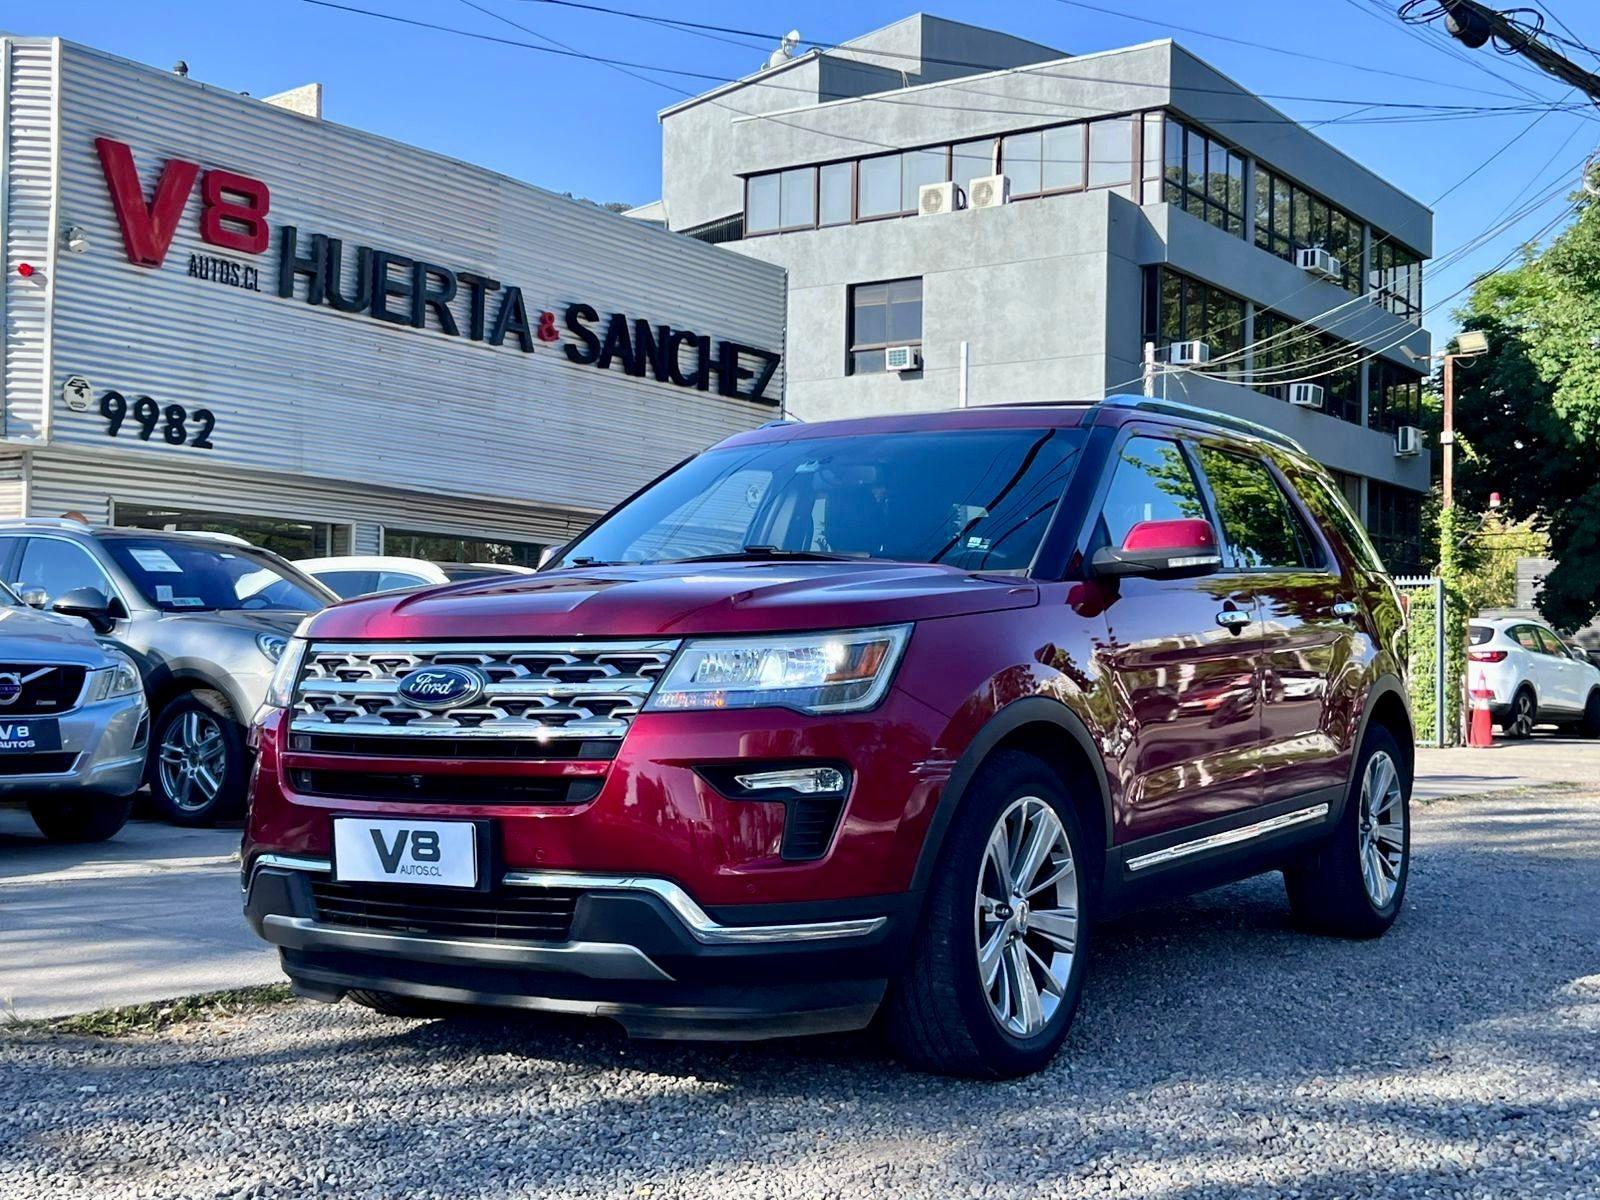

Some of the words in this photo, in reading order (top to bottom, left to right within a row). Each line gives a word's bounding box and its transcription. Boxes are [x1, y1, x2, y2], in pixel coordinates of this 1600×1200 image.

[94, 137, 271, 269] V8
[188, 254, 262, 292] AUTOS.CL
[278, 225, 535, 353] HUERTA
[537, 311, 560, 342] &
[564, 303, 782, 407] SANCHEZ
[100, 390, 216, 450] 9982
[409, 672, 456, 695] Ford
[369, 828, 441, 874] V8
[400, 864, 442, 877] AUTOS.CL
